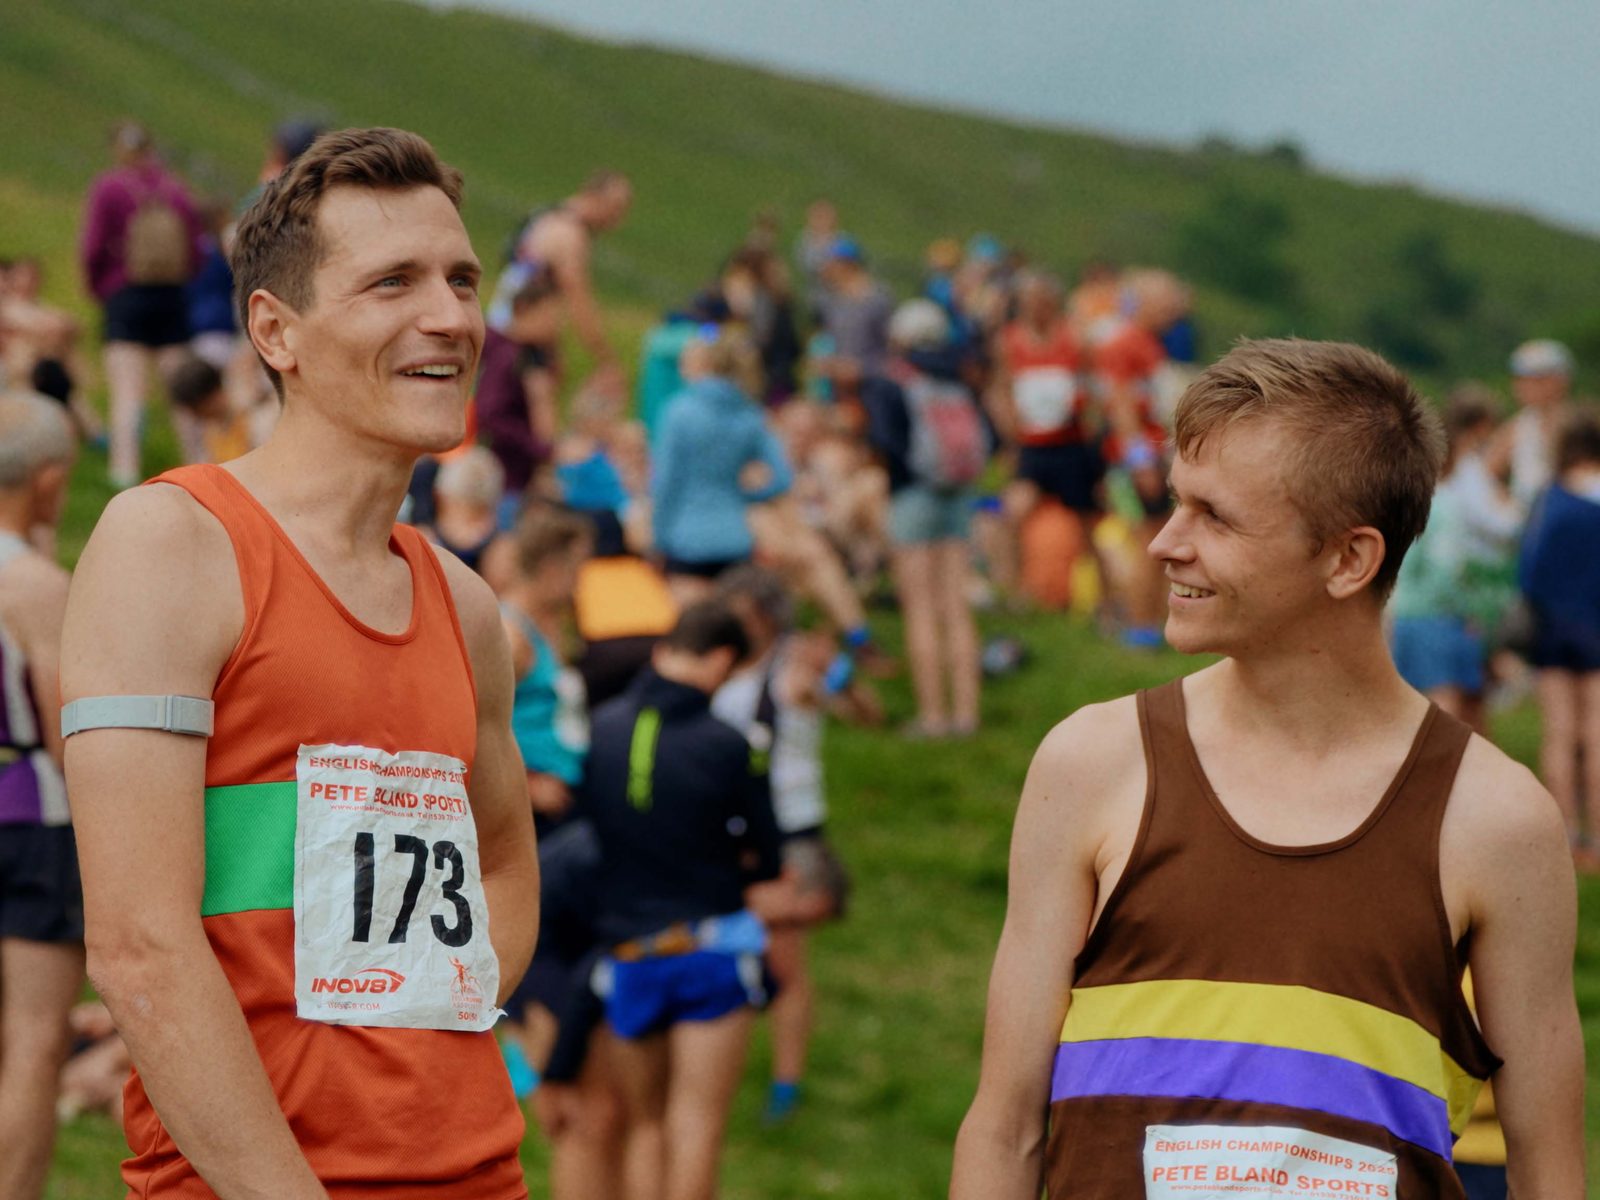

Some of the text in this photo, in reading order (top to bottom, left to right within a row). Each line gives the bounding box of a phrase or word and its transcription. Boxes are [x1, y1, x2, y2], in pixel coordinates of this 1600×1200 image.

[309, 757, 378, 771] ENGLISH
[310, 782, 368, 802] PETE
[374, 787, 418, 809] BLAND
[352, 832, 473, 948] 173
[311, 978, 386, 993] INOV8
[1155, 1139, 1395, 1175] ENGLISH CHAMPIONSHIPS 2025
[1152, 1165, 1389, 1197] PETE BLAND SPORTS
